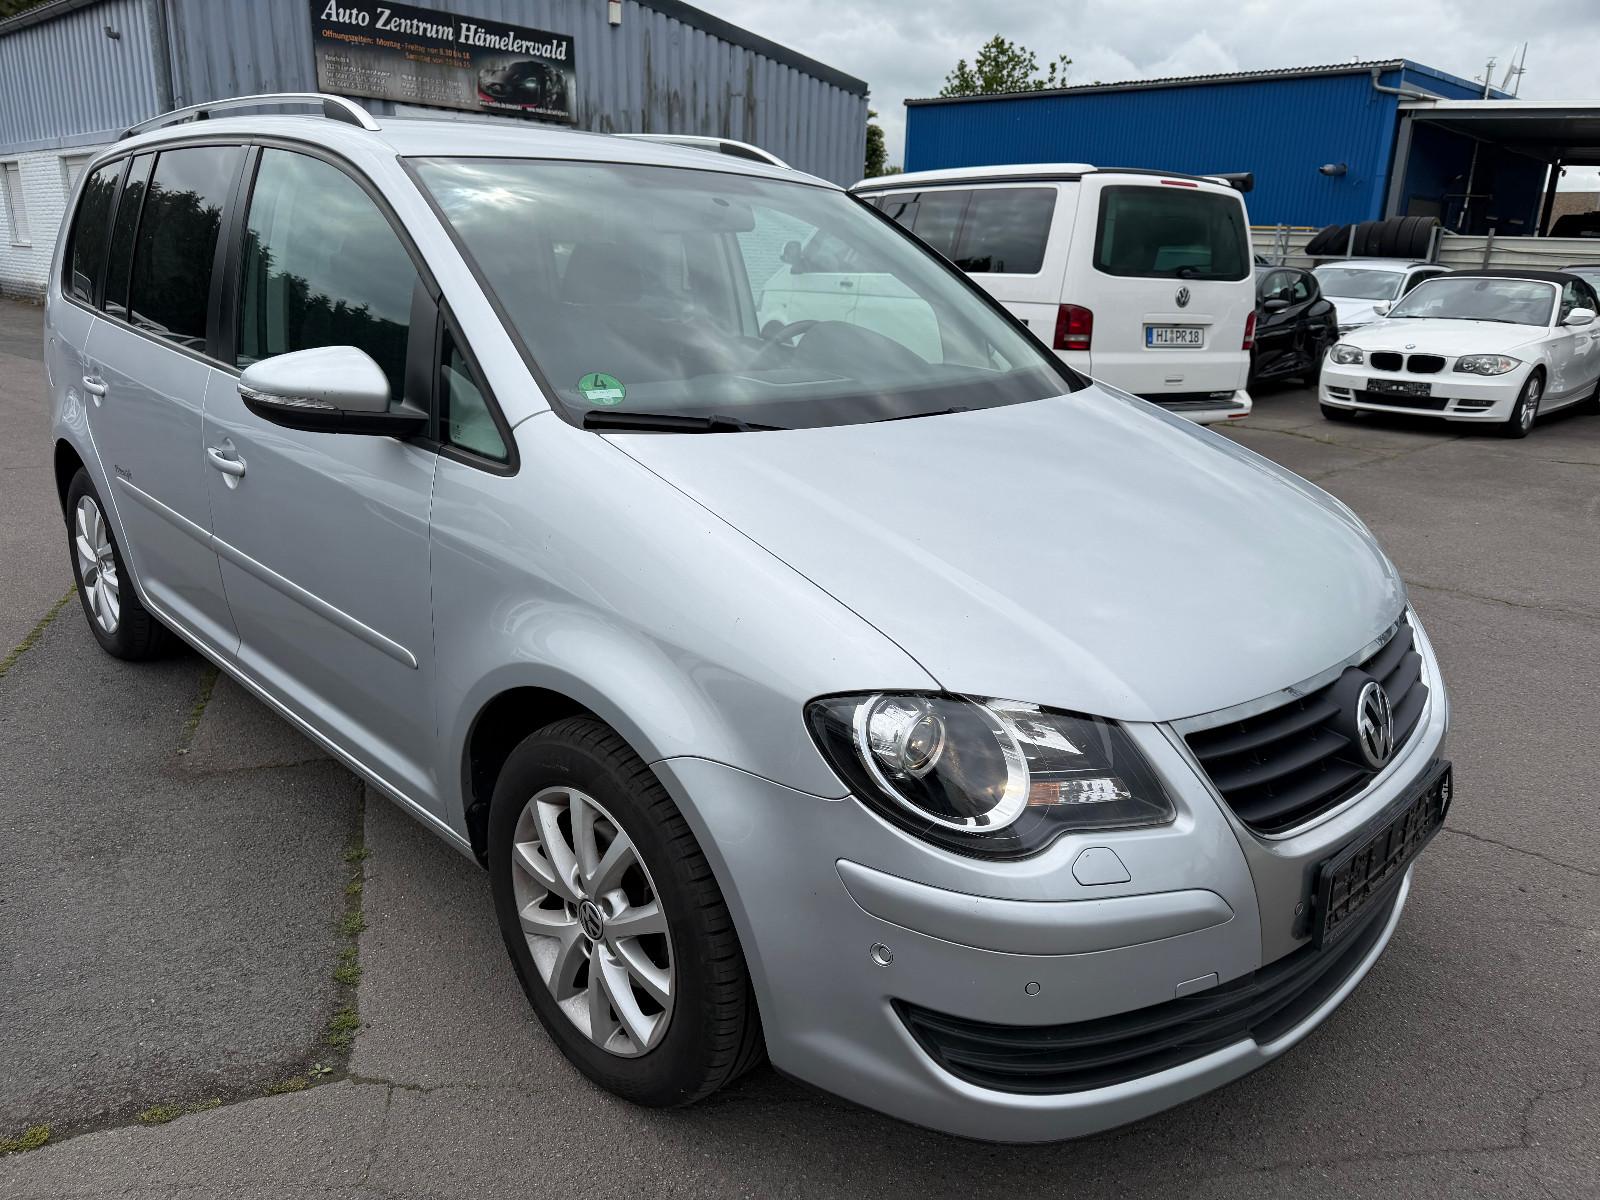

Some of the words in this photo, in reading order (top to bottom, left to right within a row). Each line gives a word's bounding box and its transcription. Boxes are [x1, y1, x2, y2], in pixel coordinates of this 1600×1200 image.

[321, 0, 370, 27] Auto
[375, 8, 454, 41] Zentrum
[458, 22, 567, 61] Hämelerwald
[1156, 330, 1168, 343] HI
[593, 374, 607, 389] 4
